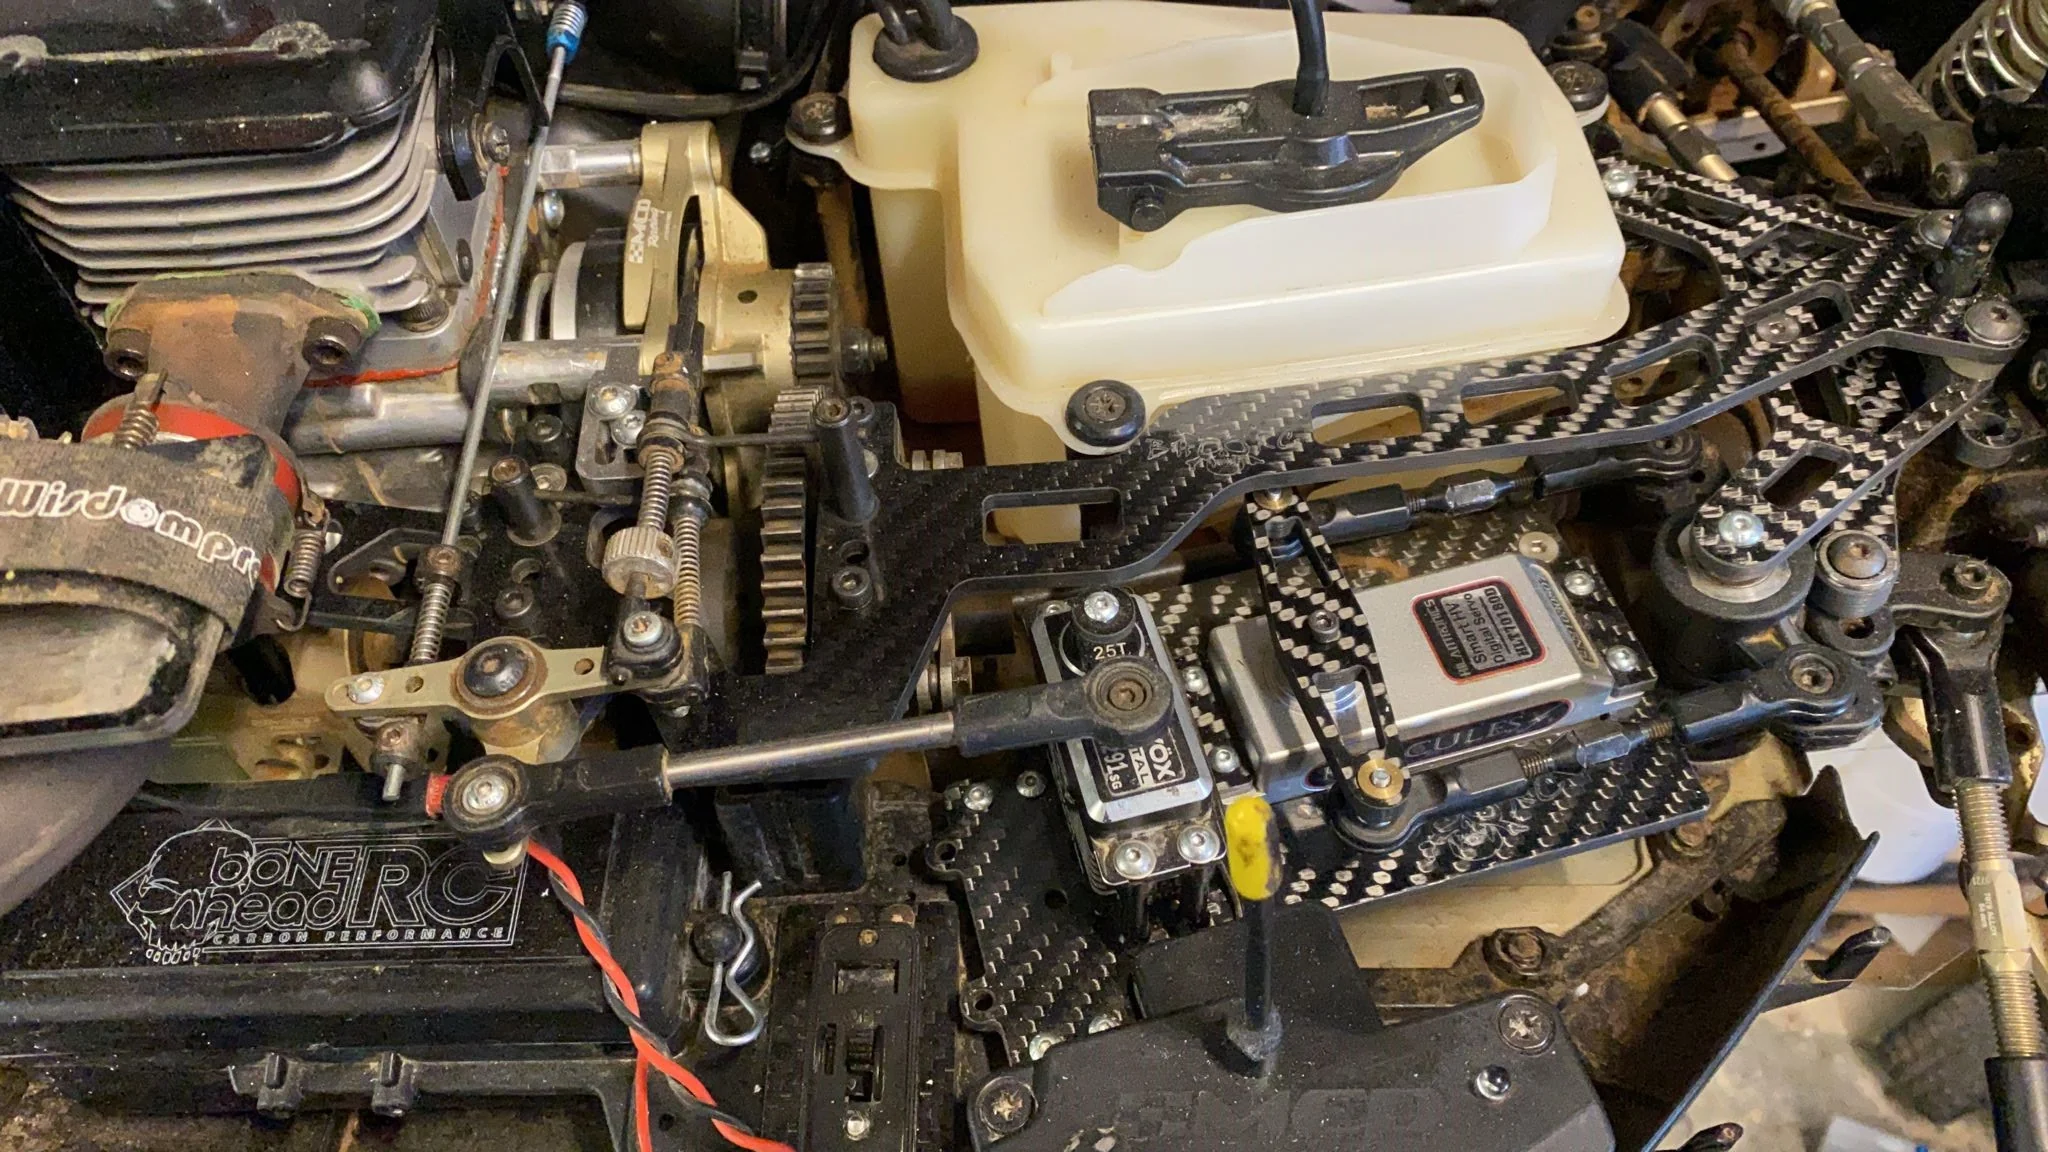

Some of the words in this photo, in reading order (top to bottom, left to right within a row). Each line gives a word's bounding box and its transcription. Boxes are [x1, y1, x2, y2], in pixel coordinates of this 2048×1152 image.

[1445, 602, 1466, 620] HV
[1462, 592, 1486, 625] Servo
[1483, 586, 1529, 656] HLT70180D
[1093, 642, 1127, 660] 25T
[1456, 622, 1488, 664] Smart
[1477, 625, 1506, 664] Digital
[1404, 718, 1522, 758] CULES
[347, 845, 517, 927] RC
[212, 931, 308, 945] CARBON
[324, 926, 504, 942] PERFORMANCE
